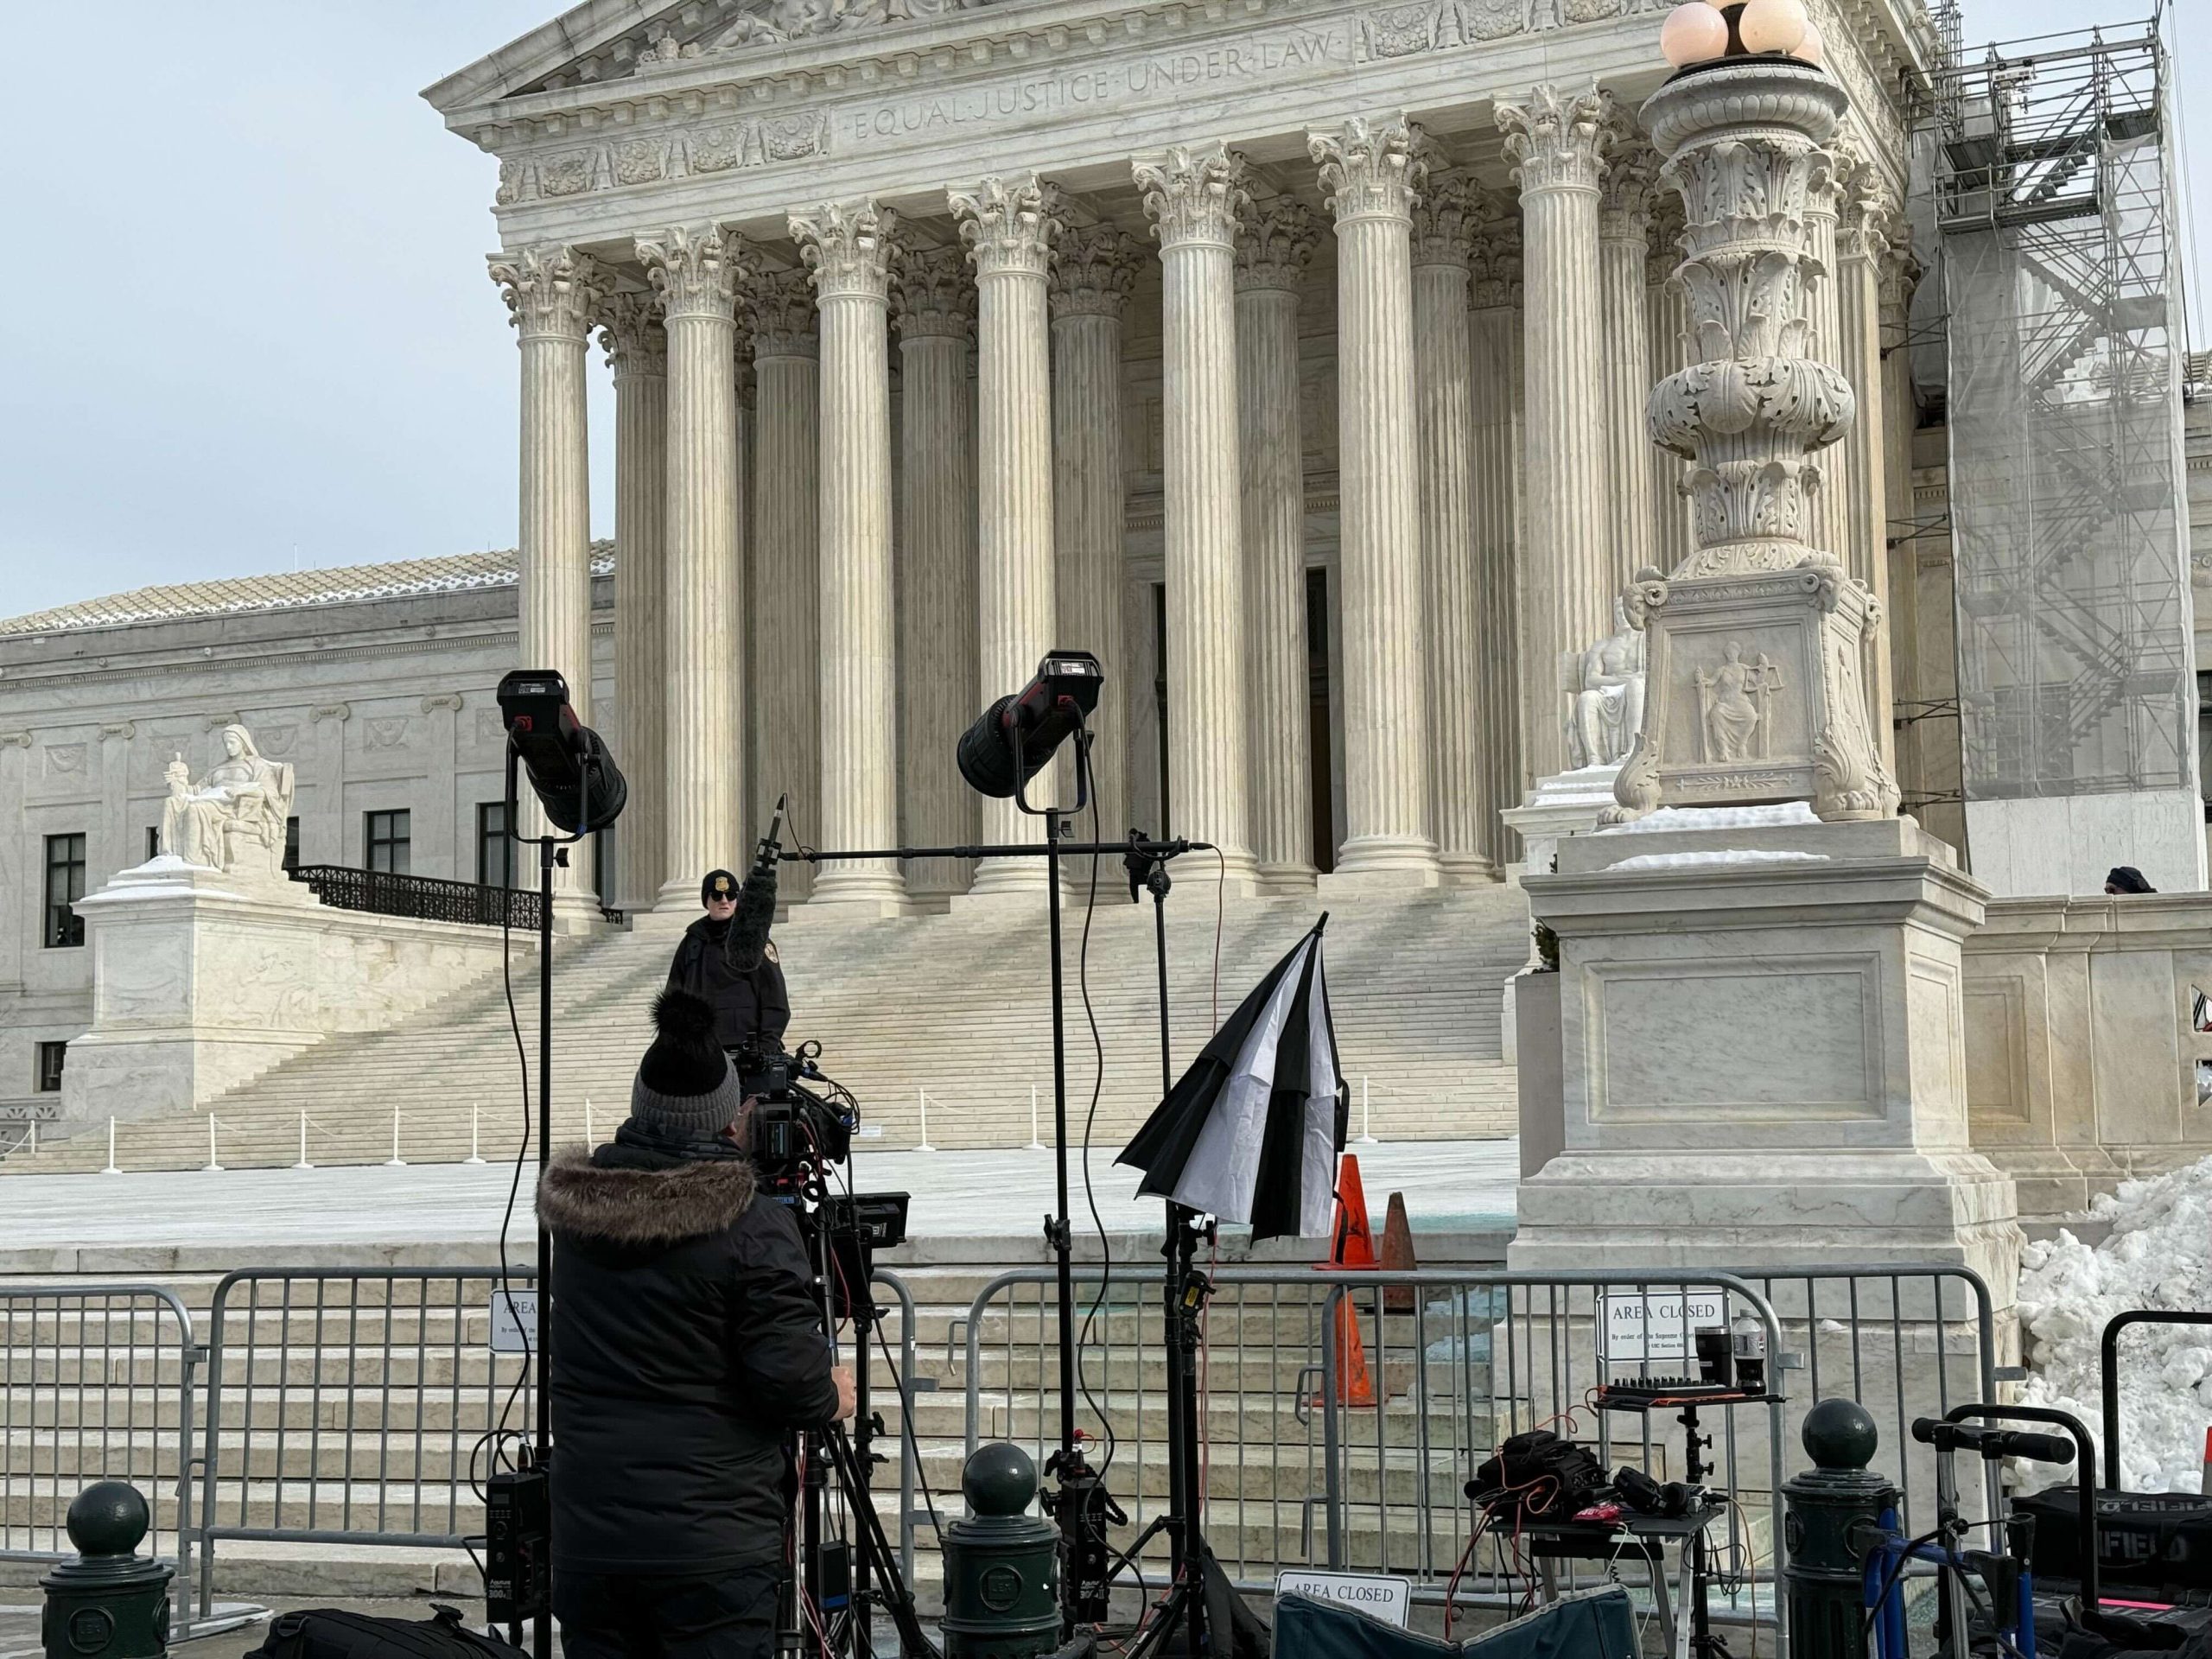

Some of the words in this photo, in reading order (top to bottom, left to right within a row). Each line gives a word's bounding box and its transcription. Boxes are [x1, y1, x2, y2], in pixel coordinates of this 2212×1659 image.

[853, 97, 965, 139] EQUAL
[973, 71, 1108, 119] JUSTICE
[1128, 48, 1249, 92] UNDER
[1262, 30, 1332, 71] LAW
[503, 1301, 536, 1314] AREA
[1338, 1586, 1394, 1602] CLOSED
